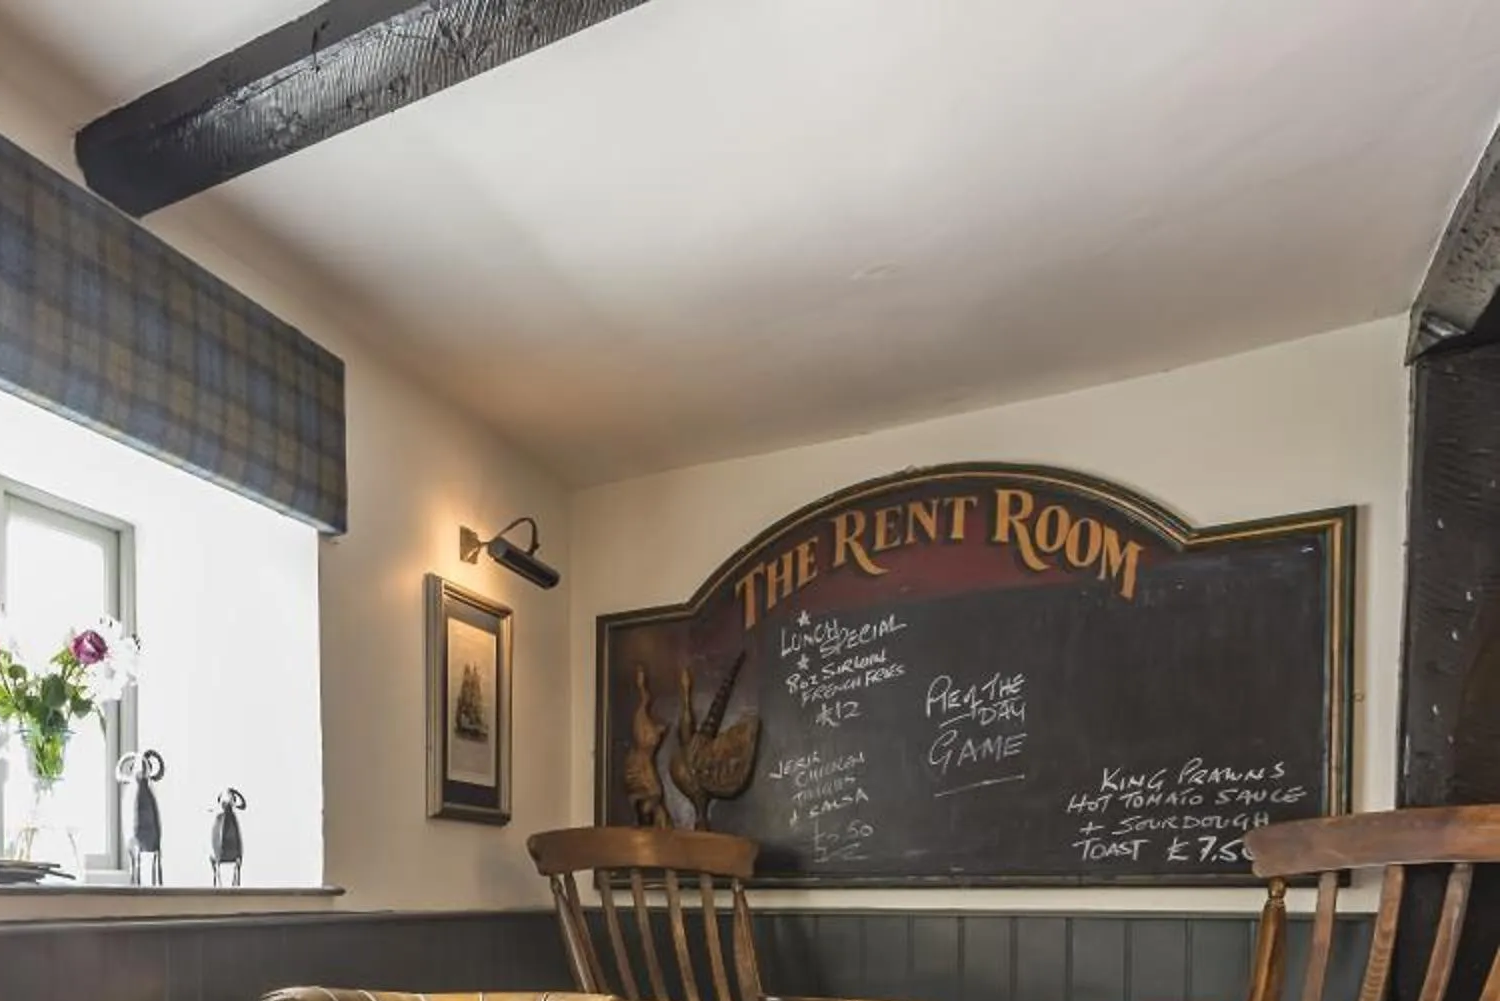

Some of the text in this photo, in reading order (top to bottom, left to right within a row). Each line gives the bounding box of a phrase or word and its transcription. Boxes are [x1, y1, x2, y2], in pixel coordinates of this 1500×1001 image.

[734, 488, 1143, 631] THE RENT ROOM
[781, 613, 907, 659] LUNCH SPECIAL
[981, 671, 1025, 701] THE
[815, 701, 863, 727] £12
[978, 701, 1027, 726] DAY
[929, 729, 1028, 775] GAME
[1100, 757, 1286, 793] KING PRAWNS
[1066, 785, 1308, 813] HOT TOMATO SAUCE
[1111, 811, 1270, 835] SOURDOUGH
[1072, 836, 1150, 862] TOAST
